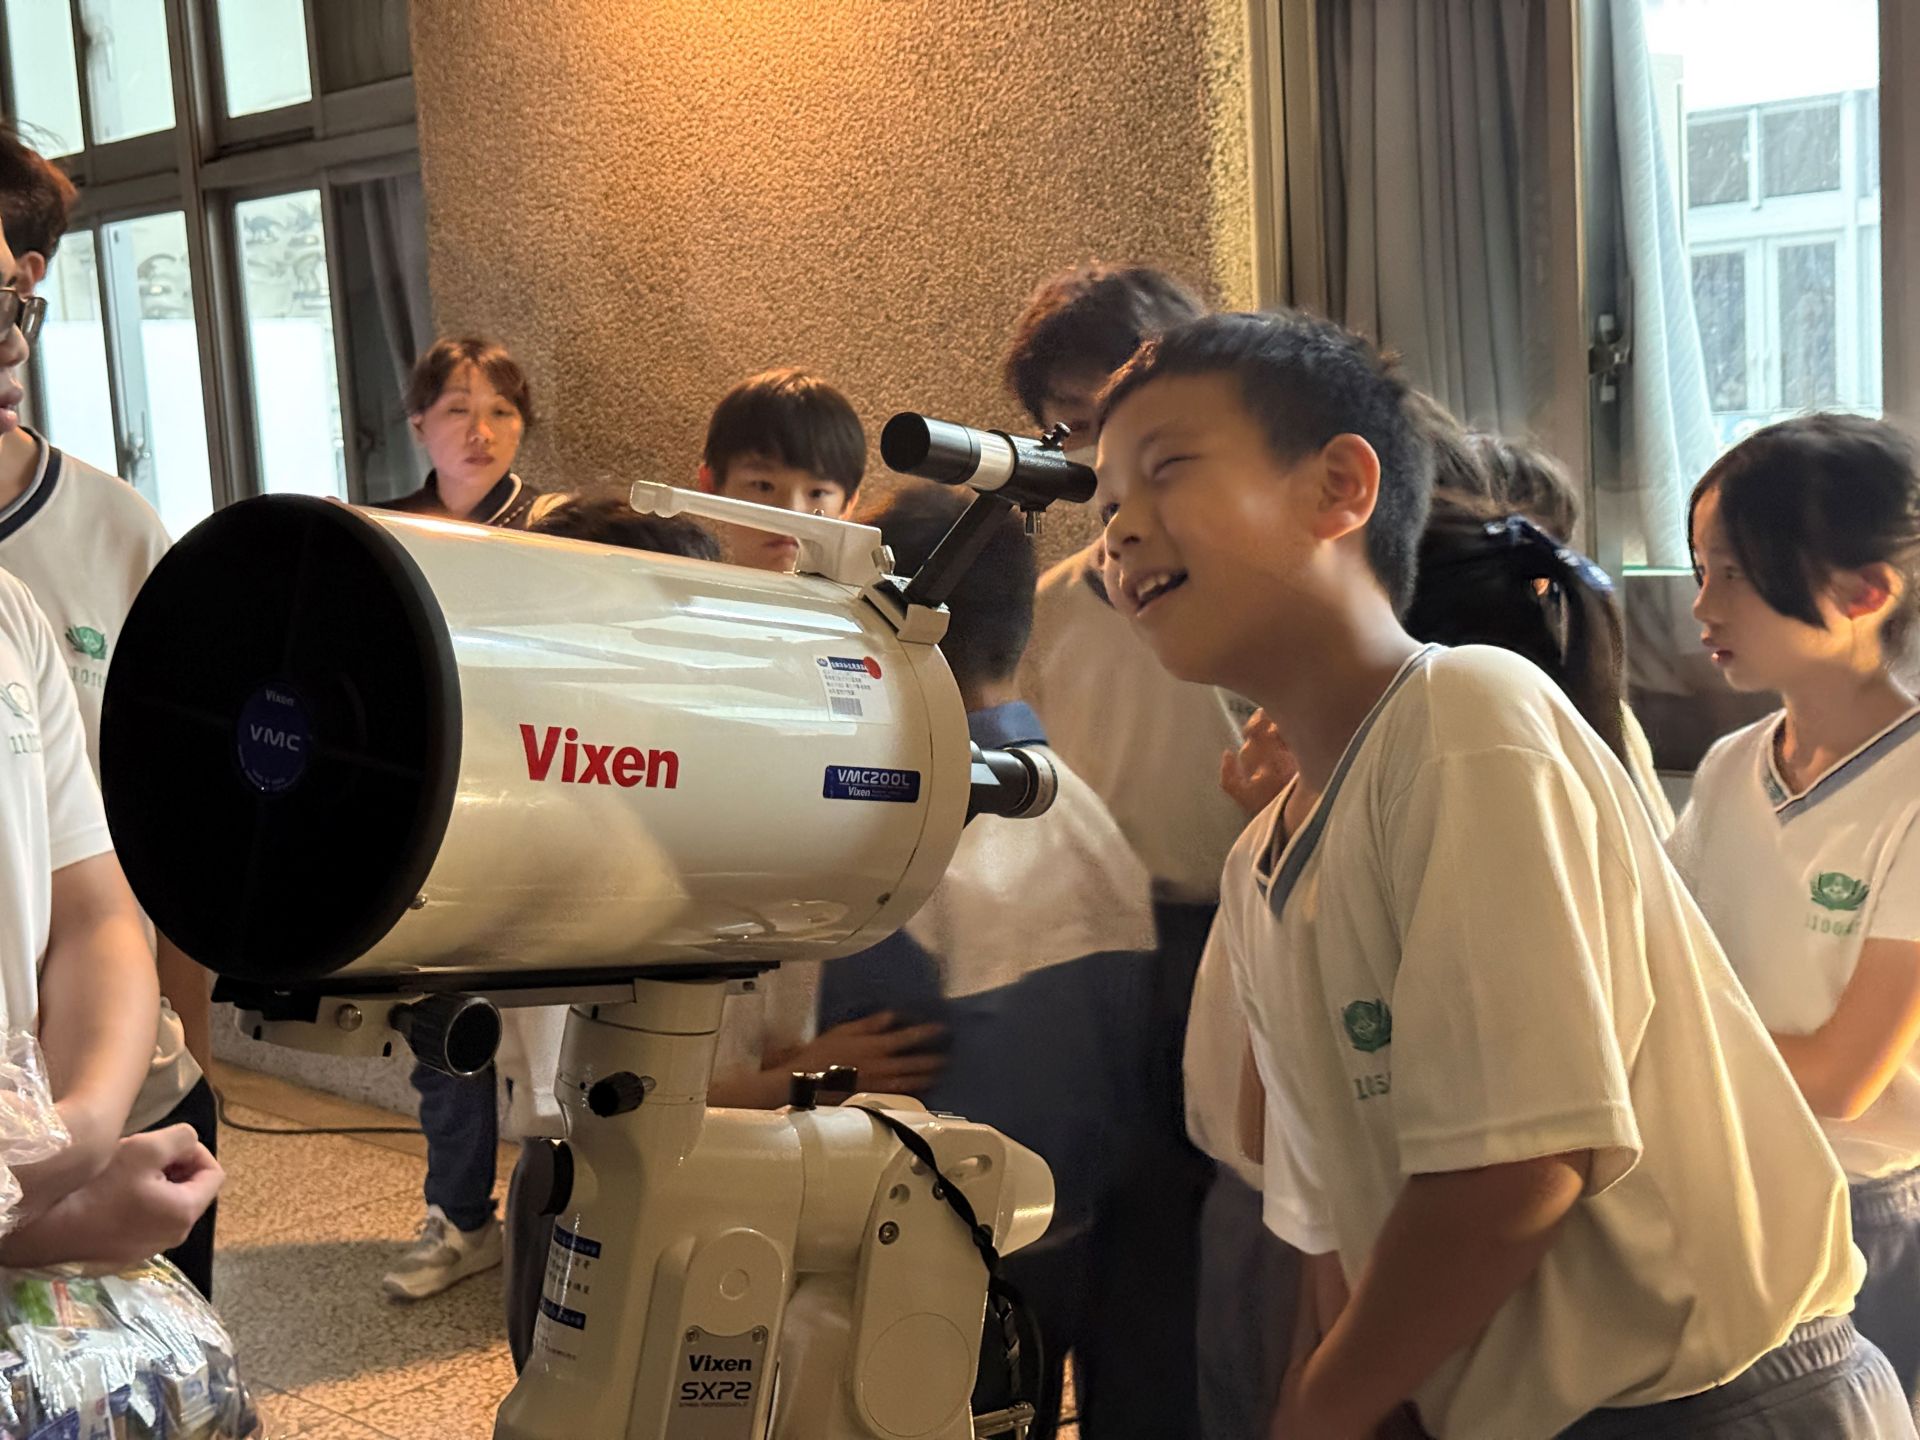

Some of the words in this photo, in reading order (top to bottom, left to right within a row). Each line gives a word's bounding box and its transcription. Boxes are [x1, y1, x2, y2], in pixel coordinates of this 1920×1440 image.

[250, 723, 301, 752] VMC
[519, 724, 679, 789] Vixen
[837, 769, 910, 786] VMC200L
[848, 786, 871, 797] Vixen
[689, 1354, 752, 1372] Vixen
[681, 1381, 752, 1401] SXP2
